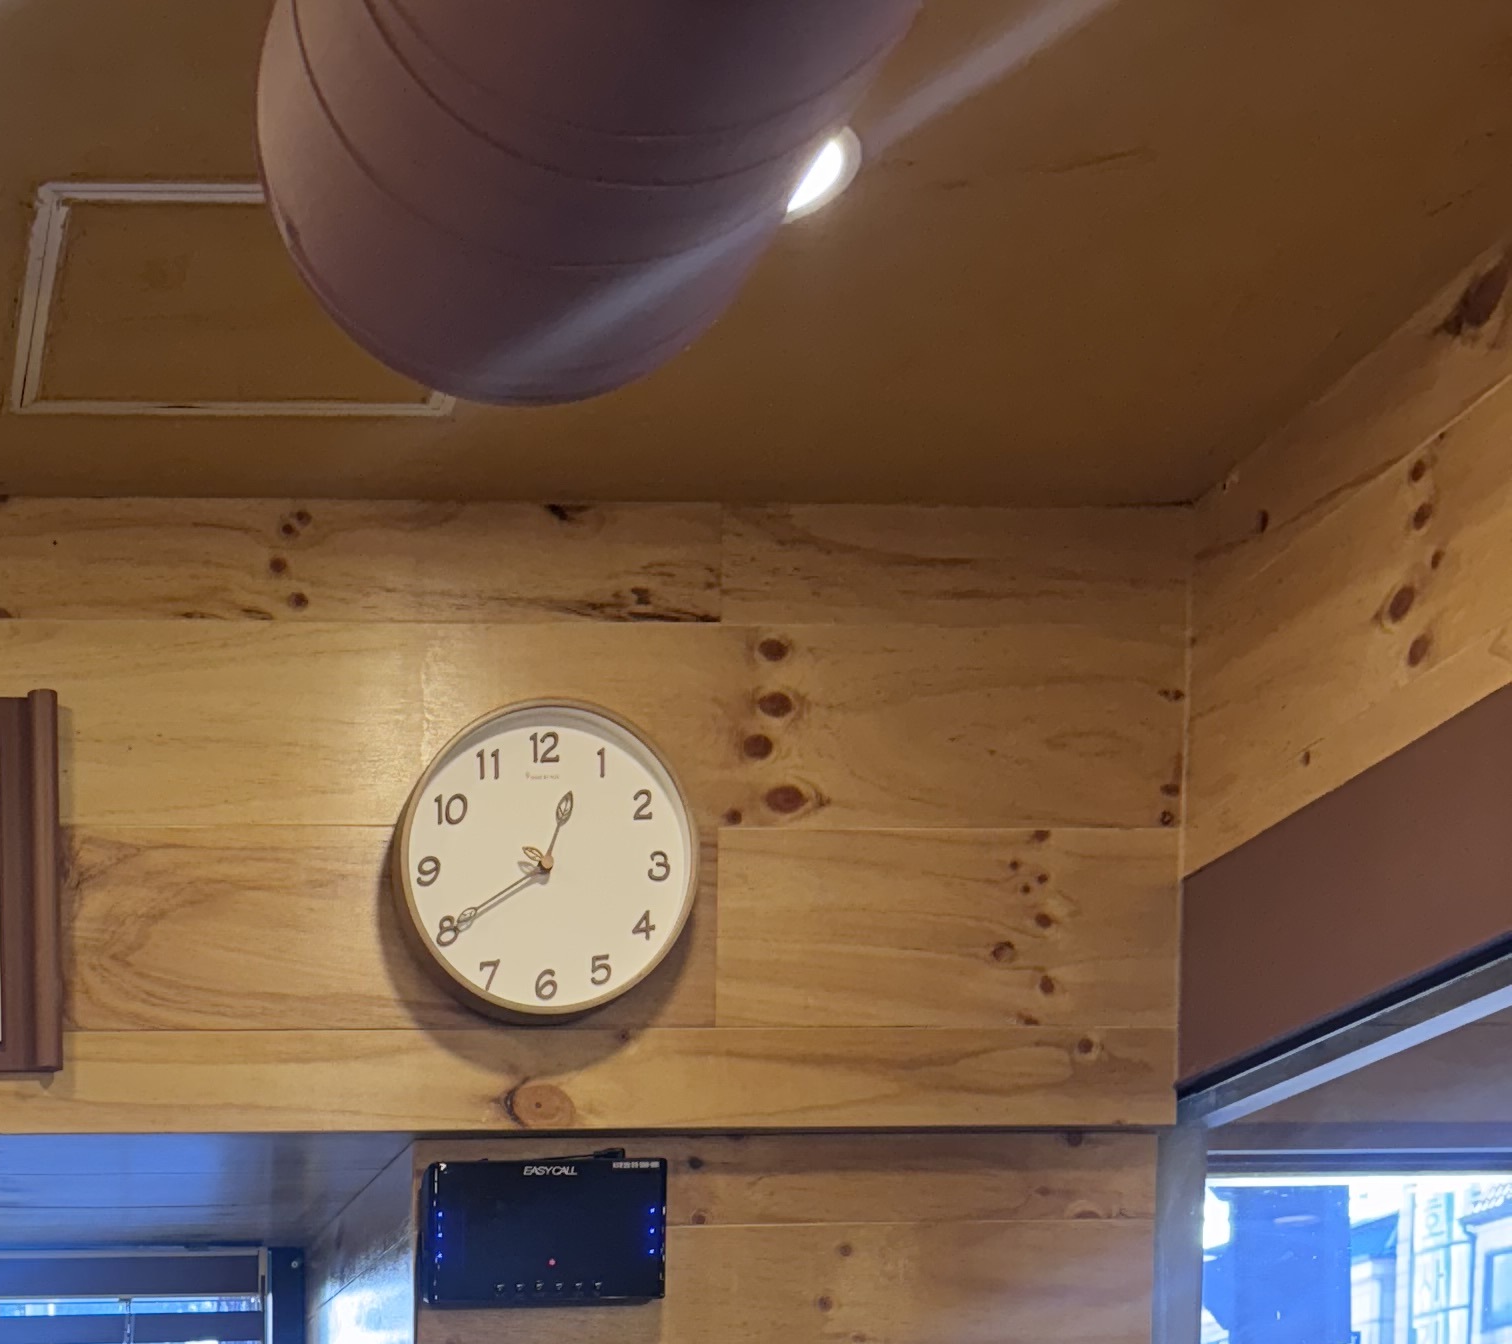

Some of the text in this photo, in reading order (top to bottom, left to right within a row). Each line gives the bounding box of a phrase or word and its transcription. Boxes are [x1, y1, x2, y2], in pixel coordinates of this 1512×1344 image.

[529, 731, 560, 763] 12
[596, 747, 606, 778] 1
[476, 748, 500, 780] 11
[434, 793, 468, 825] 10
[633, 789, 652, 820] 2
[416, 855, 441, 887] 9
[647, 850, 671, 881] 3
[436, 915, 460, 946] 8
[631, 910, 655, 940] 4
[479, 959, 501, 991] 7
[535, 968, 557, 1001] 6
[590, 954, 612, 985] 5
[523, 1165, 577, 1176] EASYCALL
